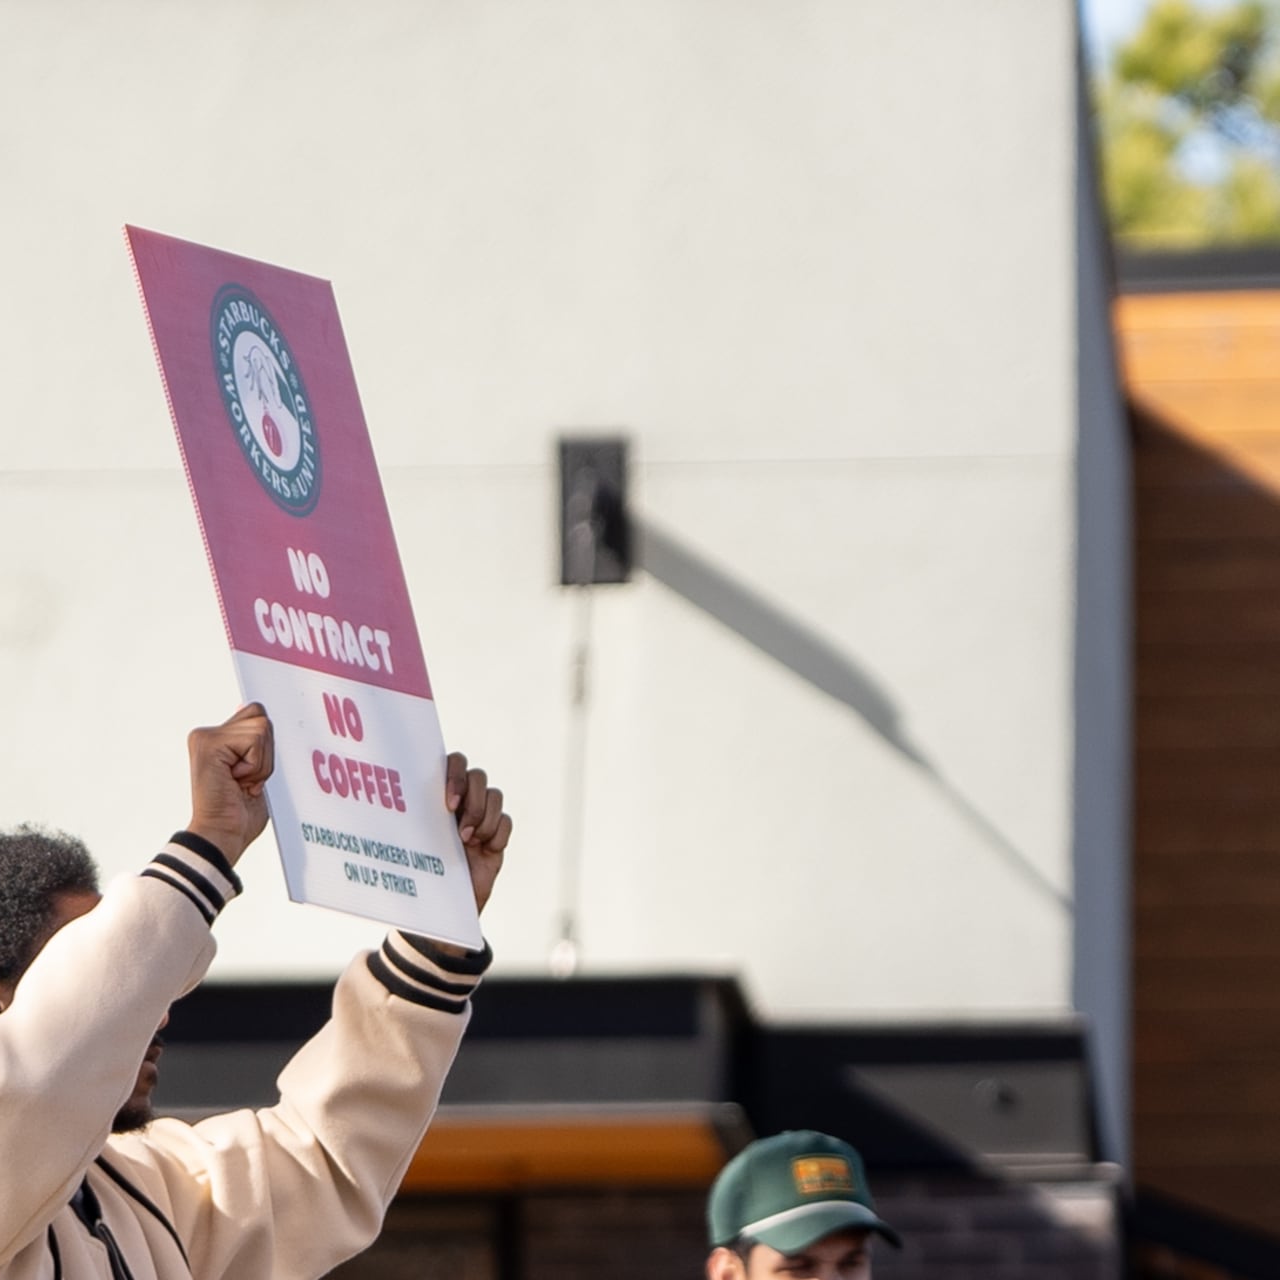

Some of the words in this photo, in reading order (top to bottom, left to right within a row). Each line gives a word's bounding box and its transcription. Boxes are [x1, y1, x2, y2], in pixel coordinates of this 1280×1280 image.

[218, 301, 290, 370] STARBUCKS
[223, 373, 291, 498] WORKERS
[294, 394, 315, 497] UNITED
[287, 547, 330, 598] NO
[254, 598, 394, 674] CONTRACT
[322, 692, 364, 742] NO
[312, 749, 407, 813] COFFEE
[301, 822, 360, 854] STARBUCKS
[359, 837, 410, 867] WORKERS
[409, 849, 445, 876] UNITED
[344, 861, 359, 882] ON
[361, 865, 379, 888] ULP
